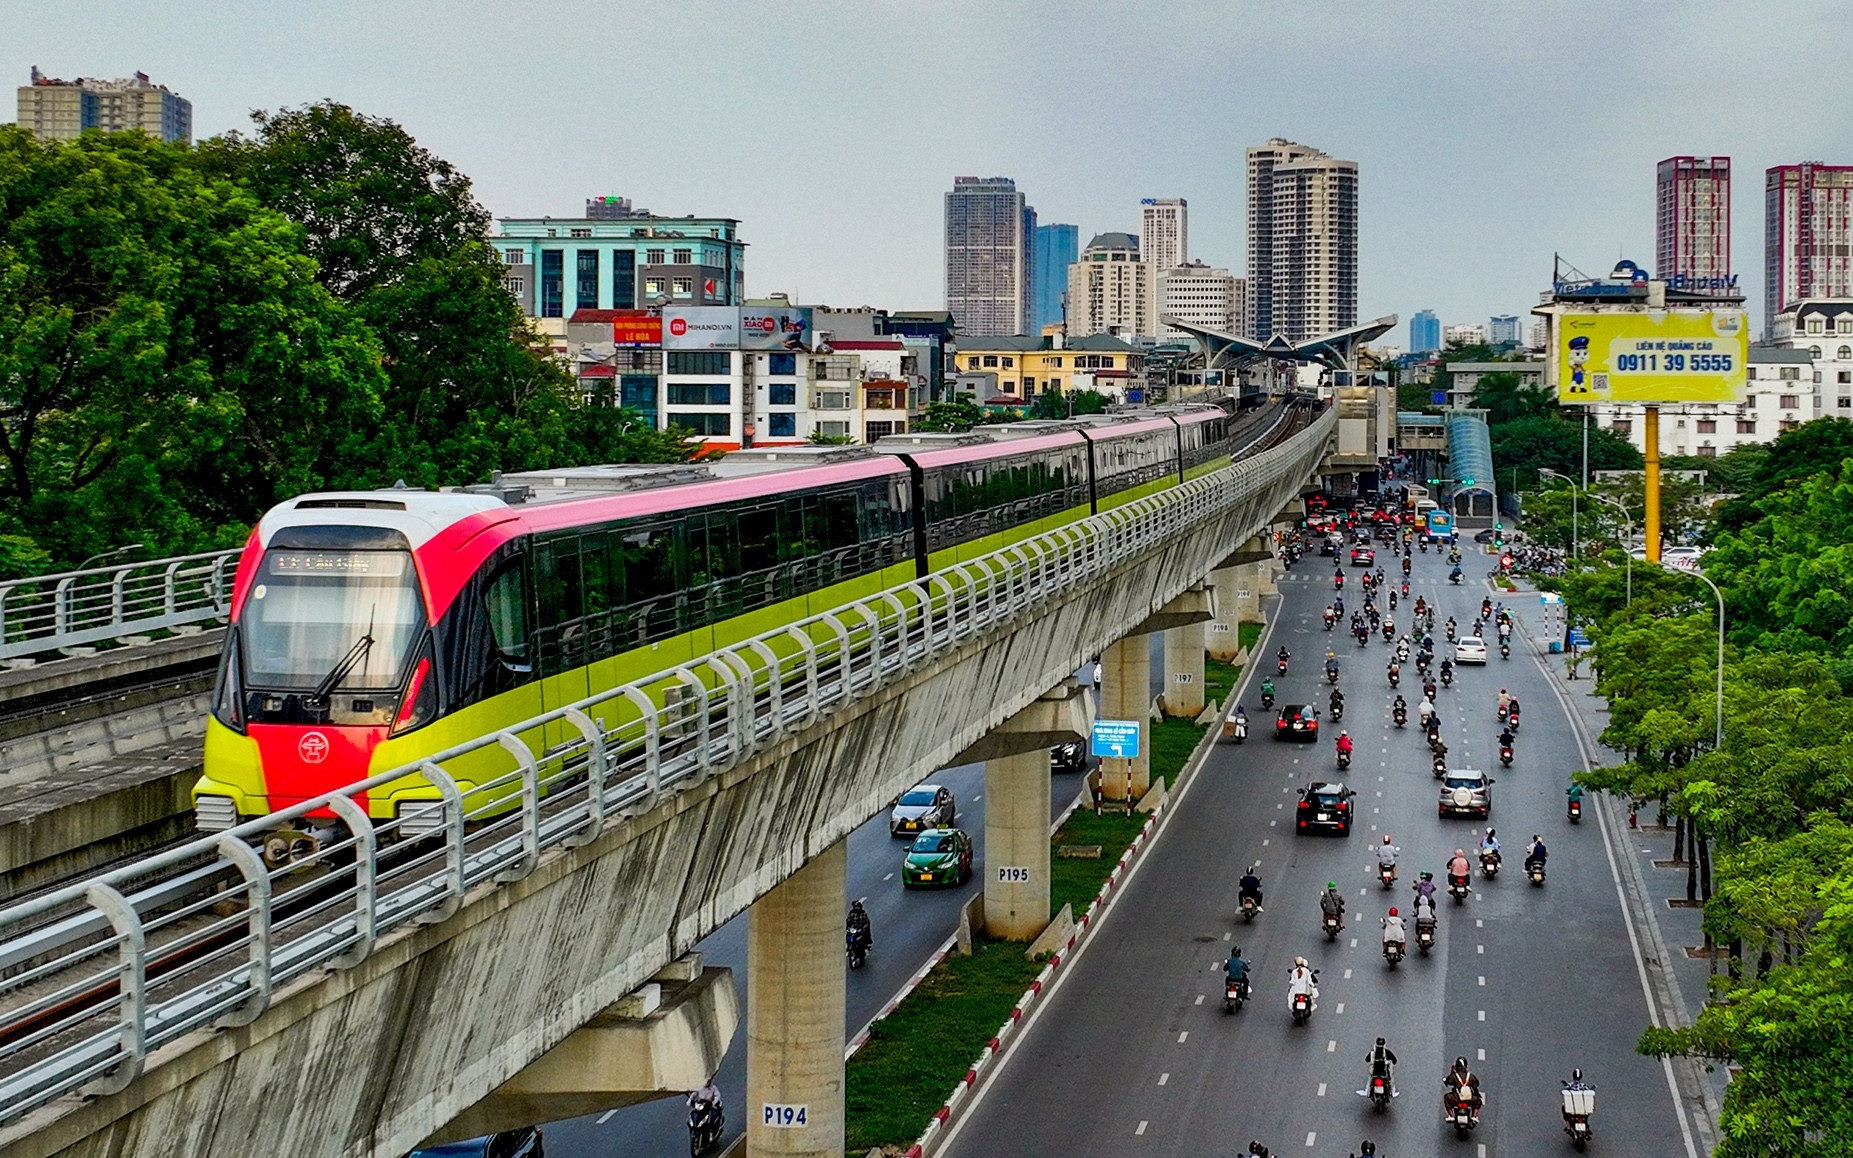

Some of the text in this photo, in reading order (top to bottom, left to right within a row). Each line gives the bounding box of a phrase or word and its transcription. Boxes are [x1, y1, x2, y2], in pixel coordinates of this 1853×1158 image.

[1617, 354, 1732, 371] 0911 39 5555
[999, 868, 1028, 881] P195
[764, 1106, 807, 1125] P194
